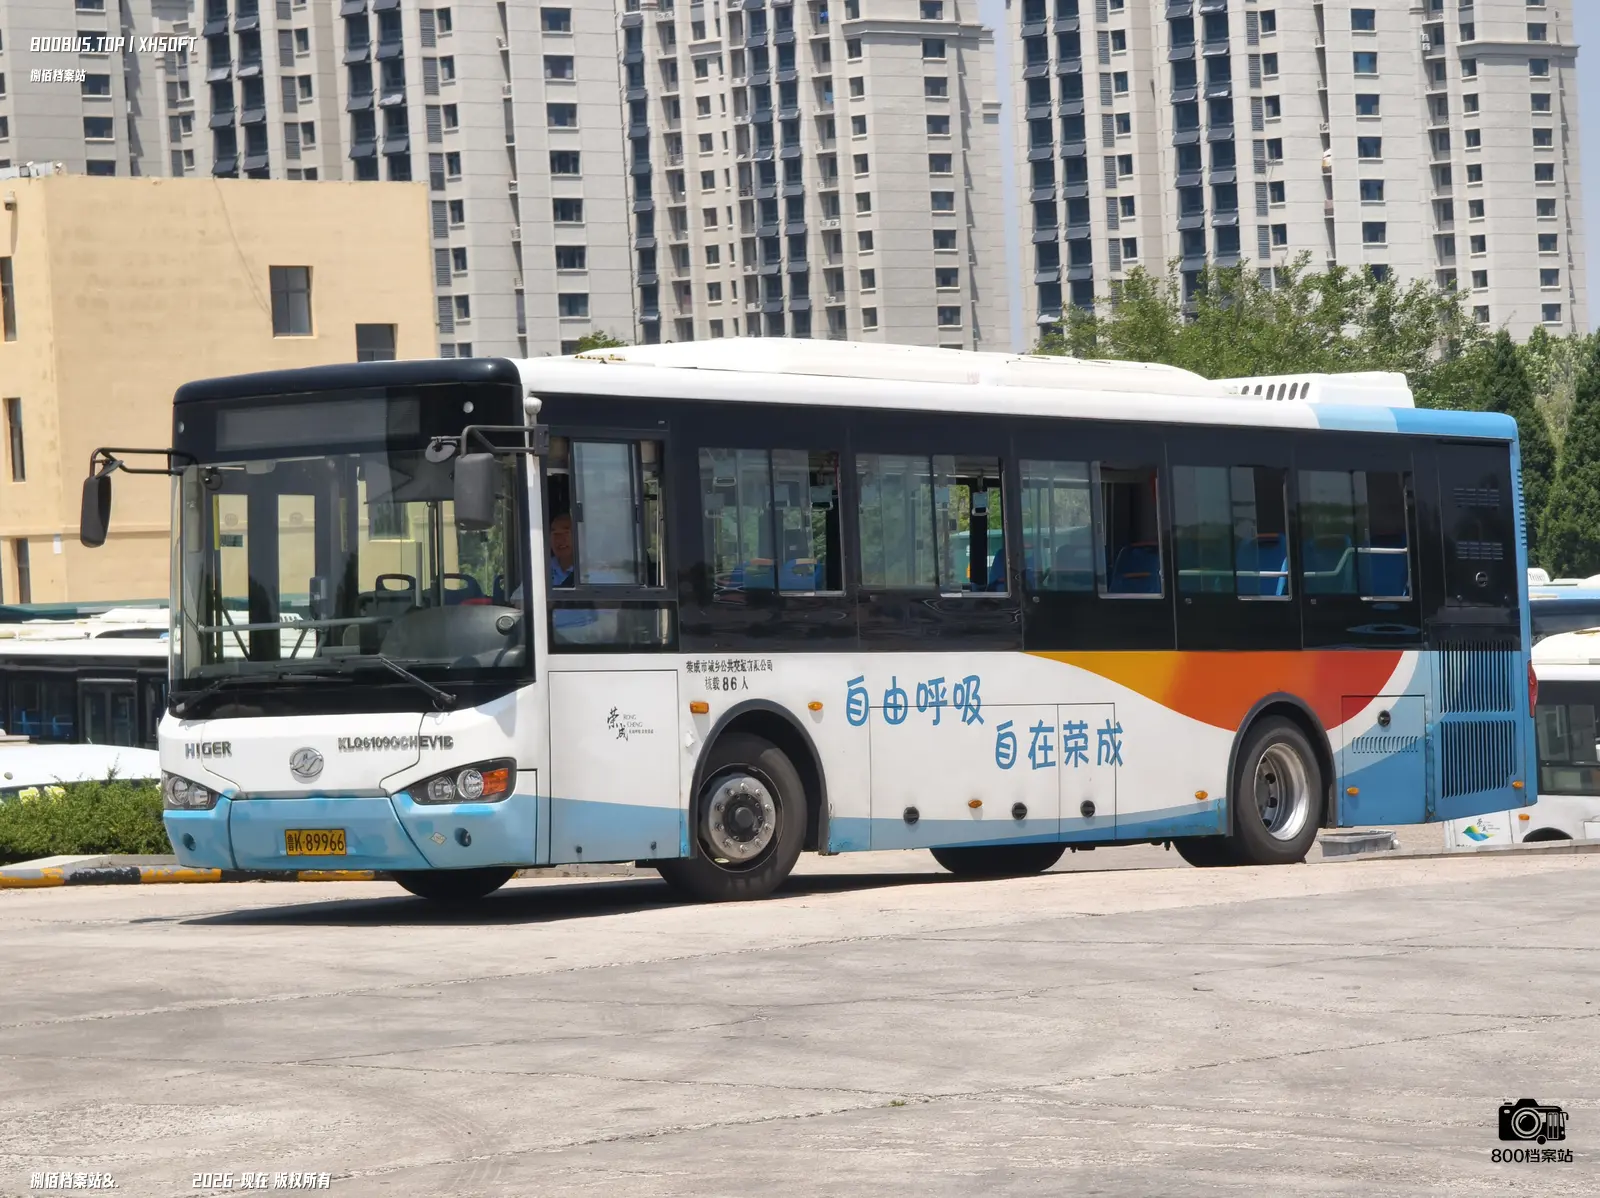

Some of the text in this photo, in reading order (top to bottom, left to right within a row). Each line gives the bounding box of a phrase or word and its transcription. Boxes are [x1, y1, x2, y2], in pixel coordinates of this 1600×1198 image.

[845, 674, 985, 727] 自由呼吸
[184, 741, 233, 758] HIGER
[994, 718, 1124, 770] 自在荣成
